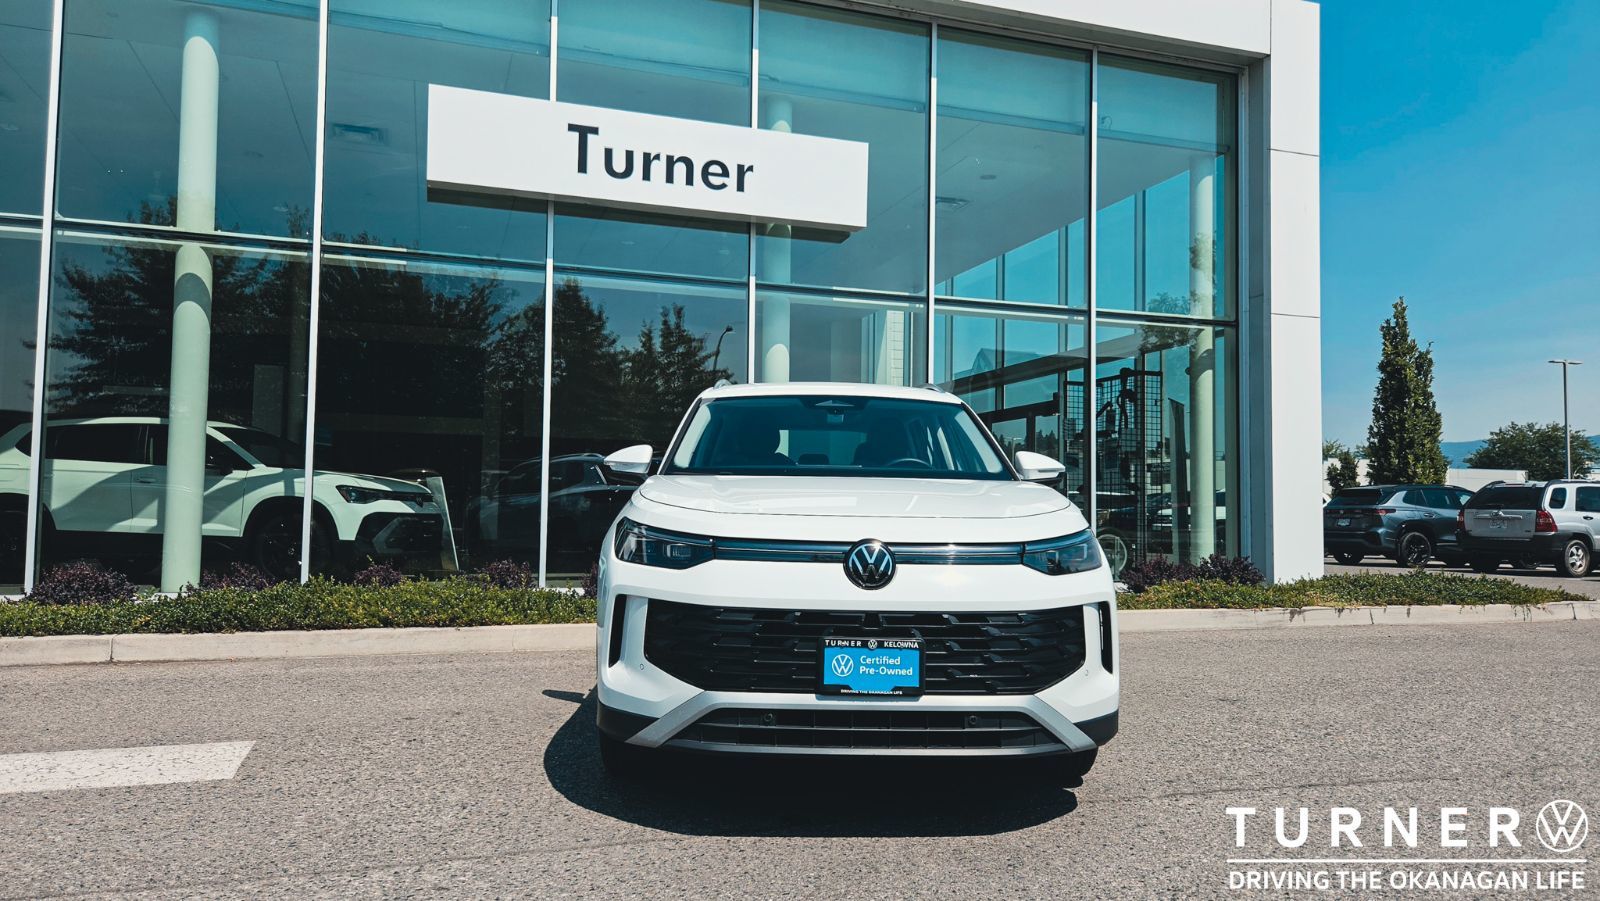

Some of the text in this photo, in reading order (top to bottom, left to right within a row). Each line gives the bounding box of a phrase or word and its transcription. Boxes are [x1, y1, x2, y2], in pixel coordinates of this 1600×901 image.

[567, 123, 754, 193] Turner
[860, 655, 901, 665] Certified
[860, 666, 913, 676] Pre-Owned
